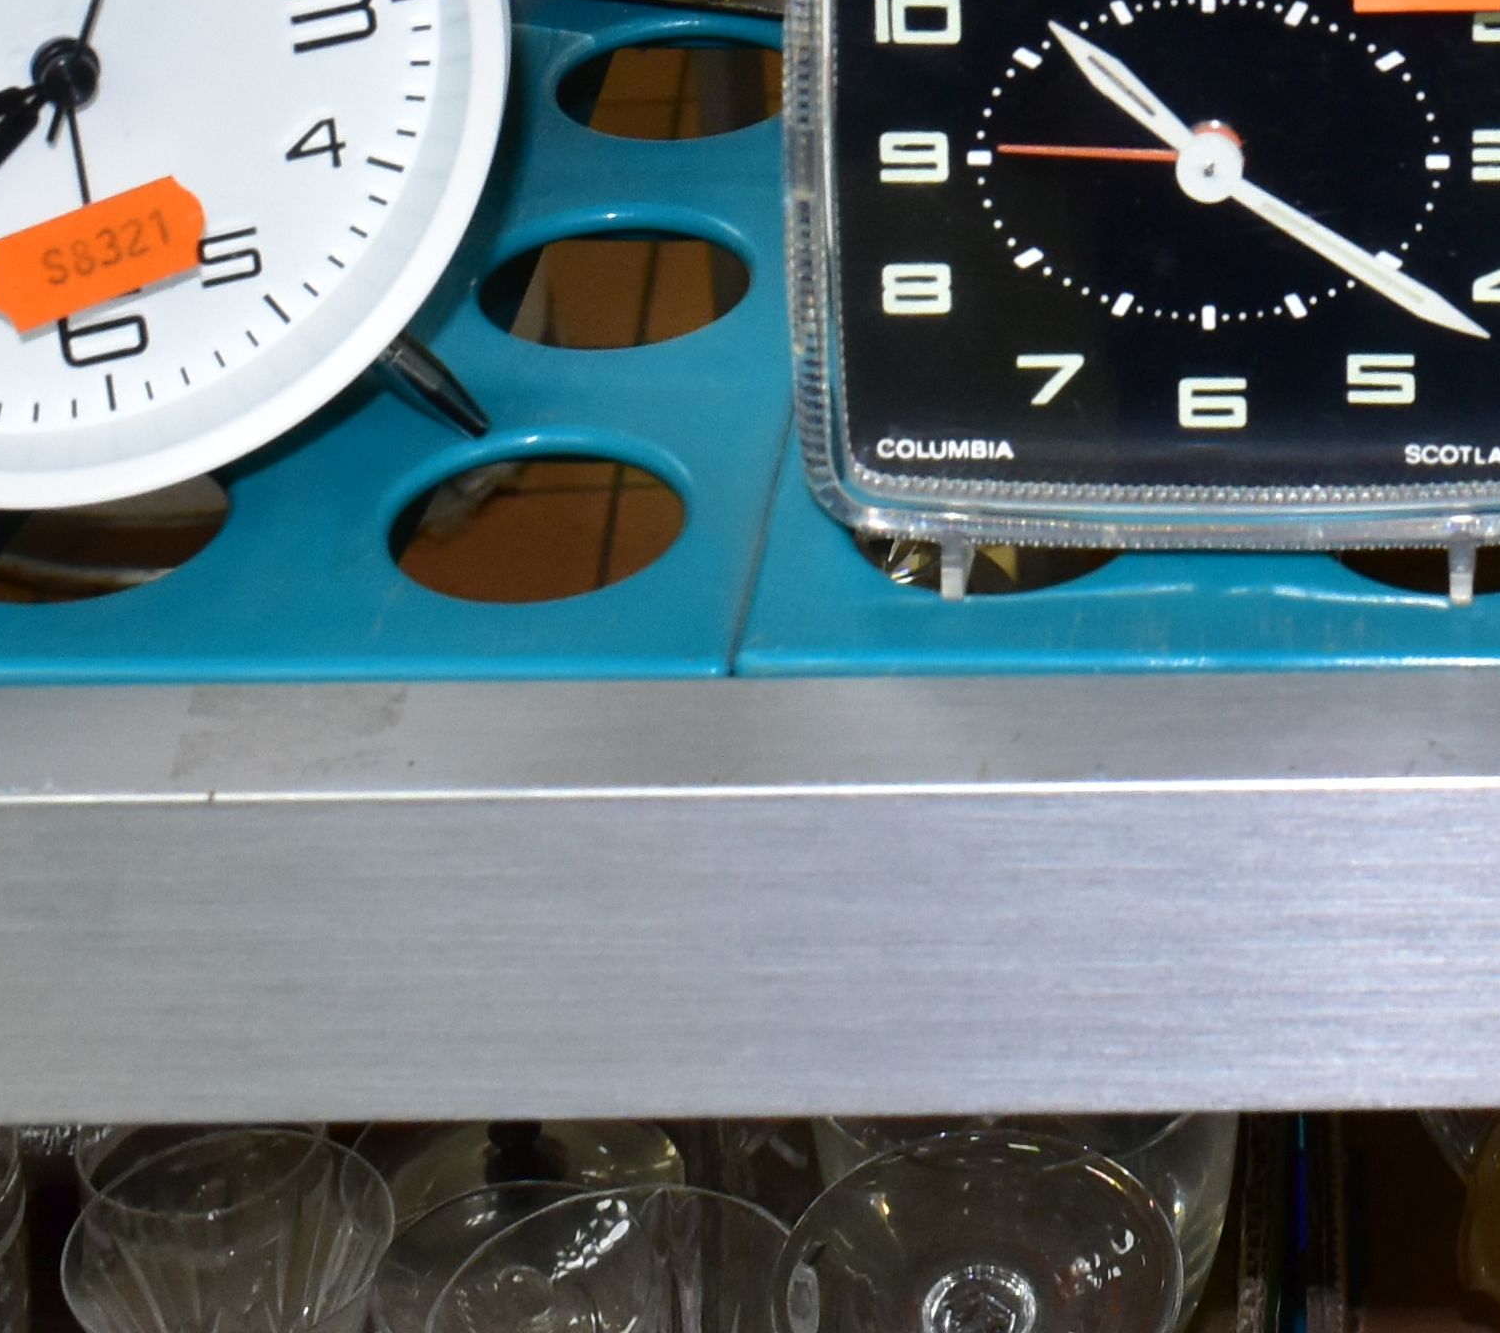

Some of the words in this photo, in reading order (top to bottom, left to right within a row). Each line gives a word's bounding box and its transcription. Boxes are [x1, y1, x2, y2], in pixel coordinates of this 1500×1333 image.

[285, 117, 347, 169] 4
[879, 130, 950, 185] 9
[40, 208, 173, 289] S8321
[198, 225, 264, 289] 5
[881, 261, 952, 316] 8
[1014, 353, 1085, 406] 7
[1177, 376, 1249, 430] 6
[1345, 353, 1417, 405] 5
[876, 436, 1015, 463] COLUMBIA
